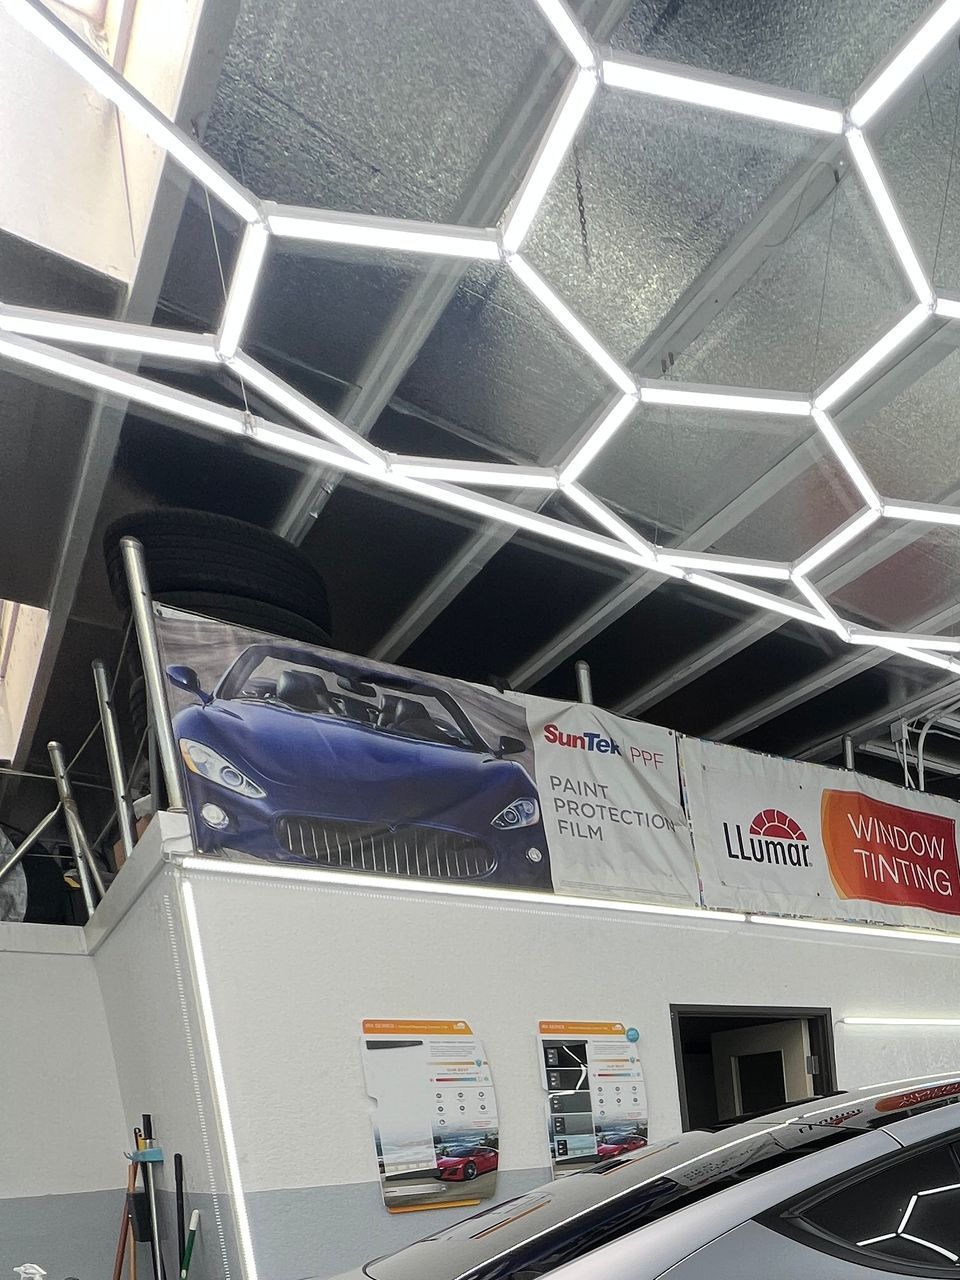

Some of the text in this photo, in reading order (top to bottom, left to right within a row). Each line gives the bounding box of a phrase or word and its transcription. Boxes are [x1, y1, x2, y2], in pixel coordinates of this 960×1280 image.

[543, 724, 664, 770] SunTek PPF
[550, 775, 608, 799] PAINT
[554, 797, 676, 833] PROTECTION
[558, 819, 604, 841] FILM
[847, 813, 945, 861] WINDOW
[853, 848, 953, 897] TINTING
